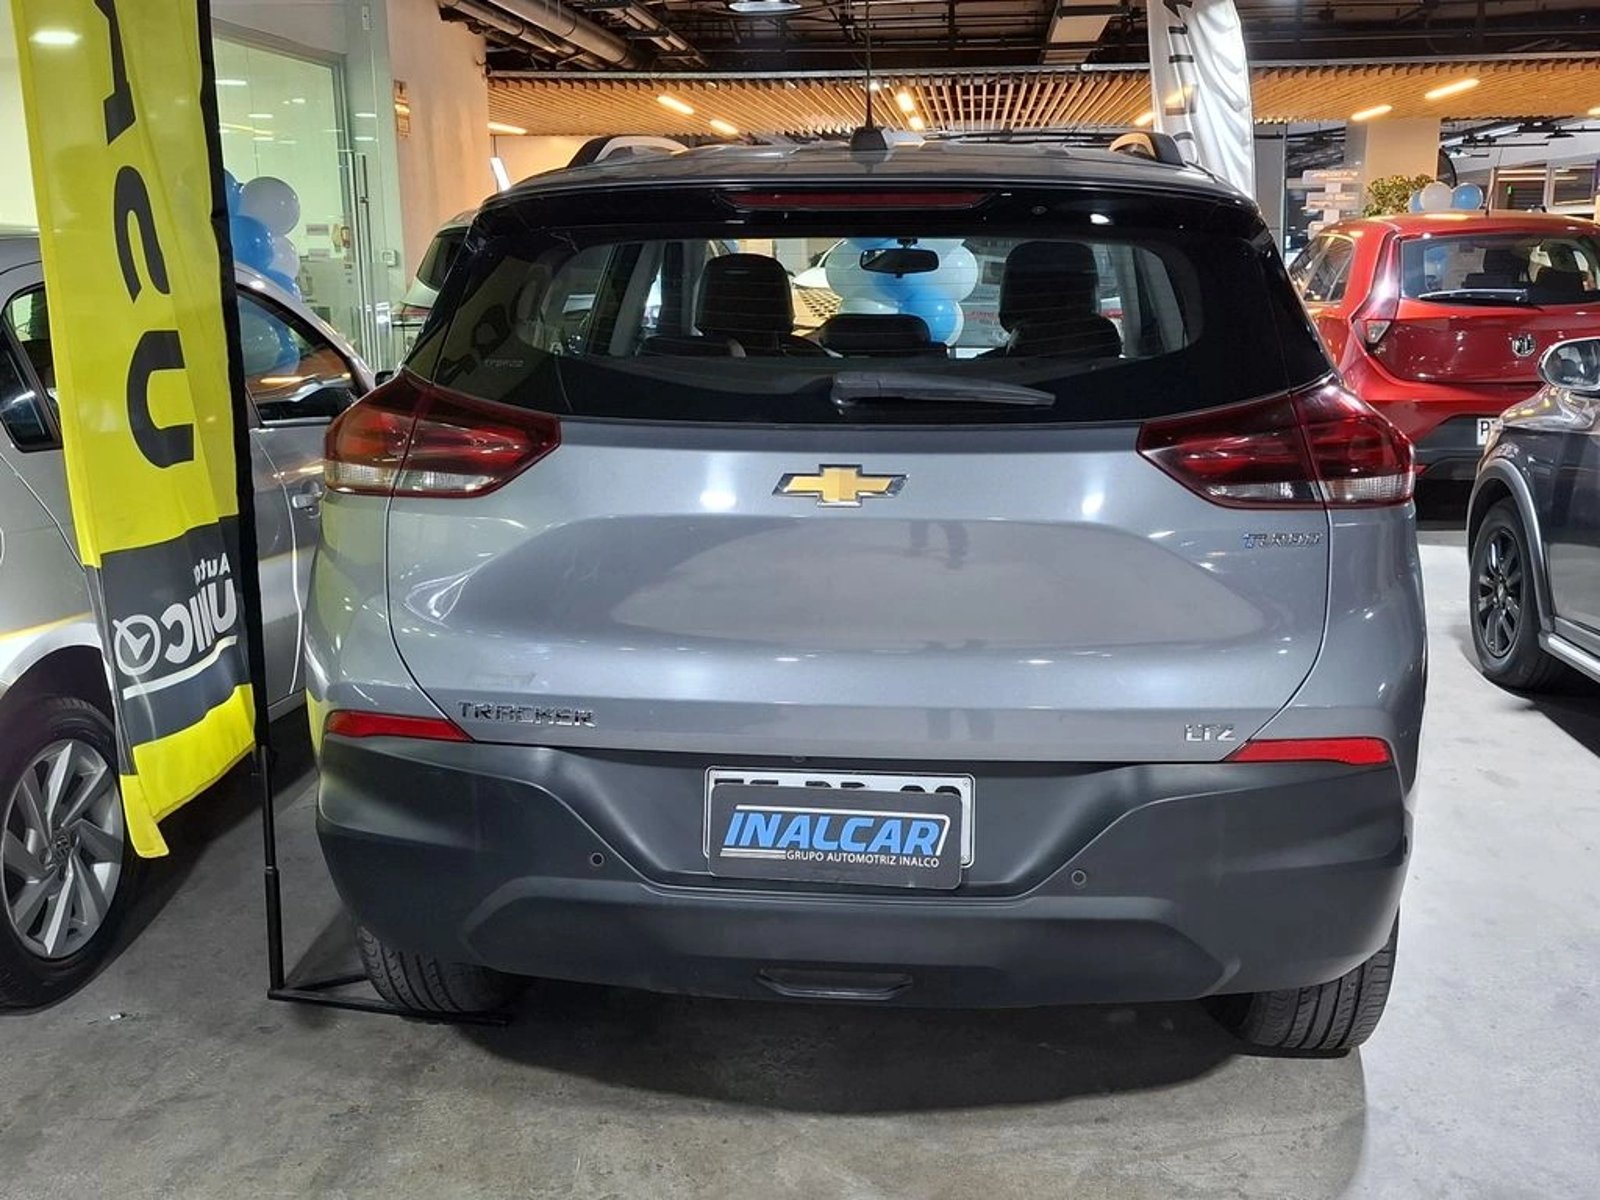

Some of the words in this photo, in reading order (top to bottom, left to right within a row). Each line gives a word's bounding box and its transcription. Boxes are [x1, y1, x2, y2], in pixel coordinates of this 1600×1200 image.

[458, 701, 597, 728] TRACKER
[1184, 723, 1236, 741] LTZ
[723, 811, 941, 856] INALCAR
[786, 850, 825, 862] GRUPO
[826, 852, 897, 866] AUTOMOTRIZ
[899, 855, 940, 868] INALCO
